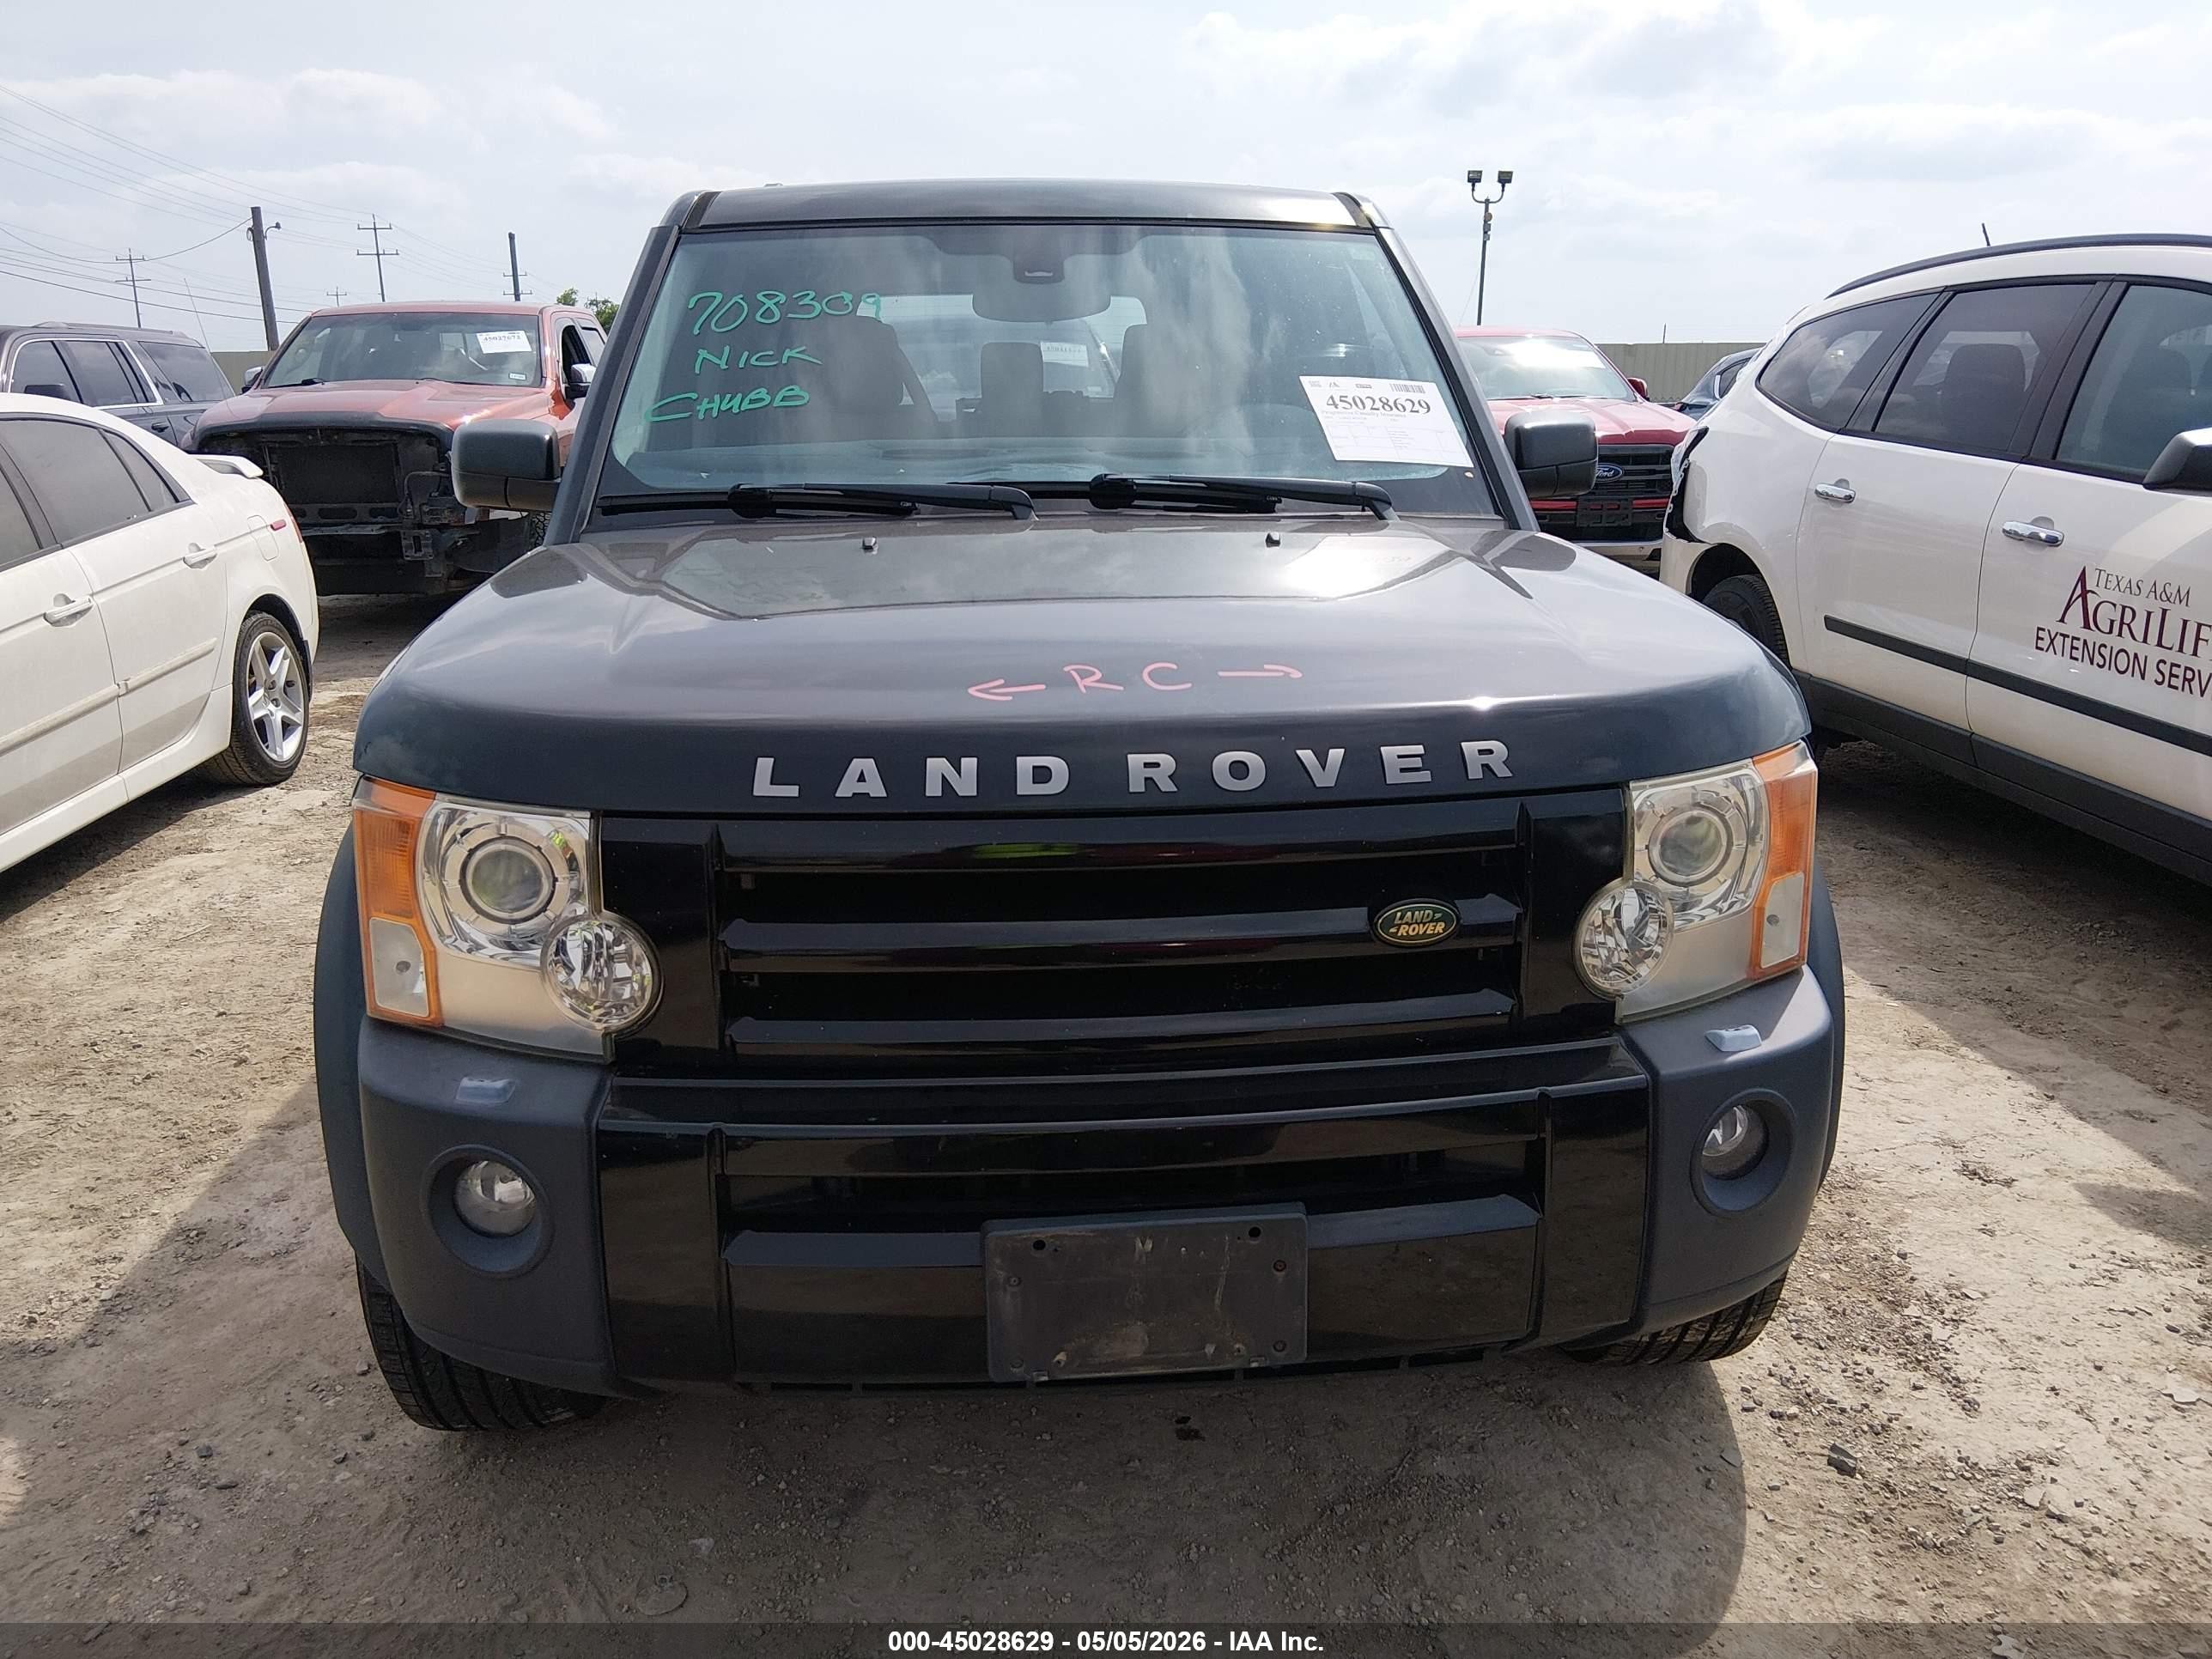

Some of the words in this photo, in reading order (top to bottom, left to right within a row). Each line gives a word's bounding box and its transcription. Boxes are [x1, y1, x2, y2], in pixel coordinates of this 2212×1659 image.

[688, 290, 882, 335] 708309
[694, 345, 823, 374] NICK
[645, 386, 810, 422] CHUBB
[1326, 394, 1431, 414] 45028629
[2095, 568, 2143, 597] TEXAS
[2145, 580, 2191, 607] A&M
[2056, 566, 2212, 661] AGRILIF
[2035, 627, 2148, 681] EXTENSION
[2154, 659, 2212, 700] SERV
[752, 756, 1070, 798] LAND
[1126, 739, 1514, 793] ROVER
[1394, 910, 1433, 924] LAND
[1397, 921, 1446, 937] ROVER
